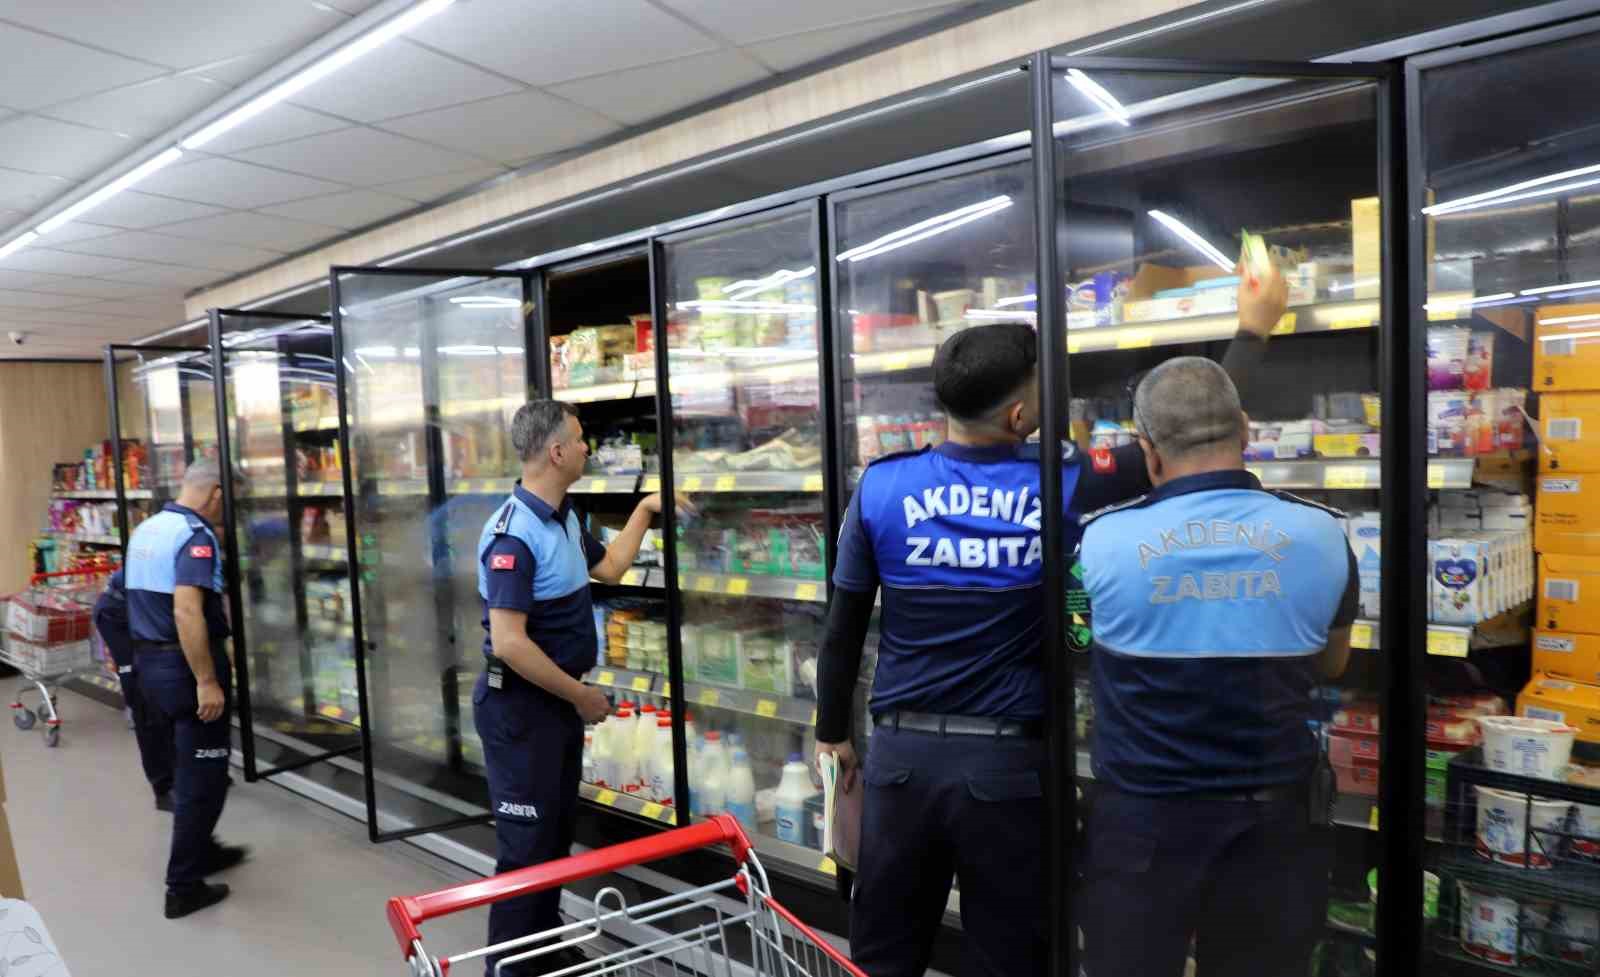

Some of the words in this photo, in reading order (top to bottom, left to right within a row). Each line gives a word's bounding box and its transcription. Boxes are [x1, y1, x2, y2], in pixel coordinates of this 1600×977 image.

[905, 536, 1042, 568] ZABITA
[1137, 520, 1291, 569] AKDENİZ
[1151, 570, 1281, 604] ZABITA
[498, 801, 538, 818] ZABITA
